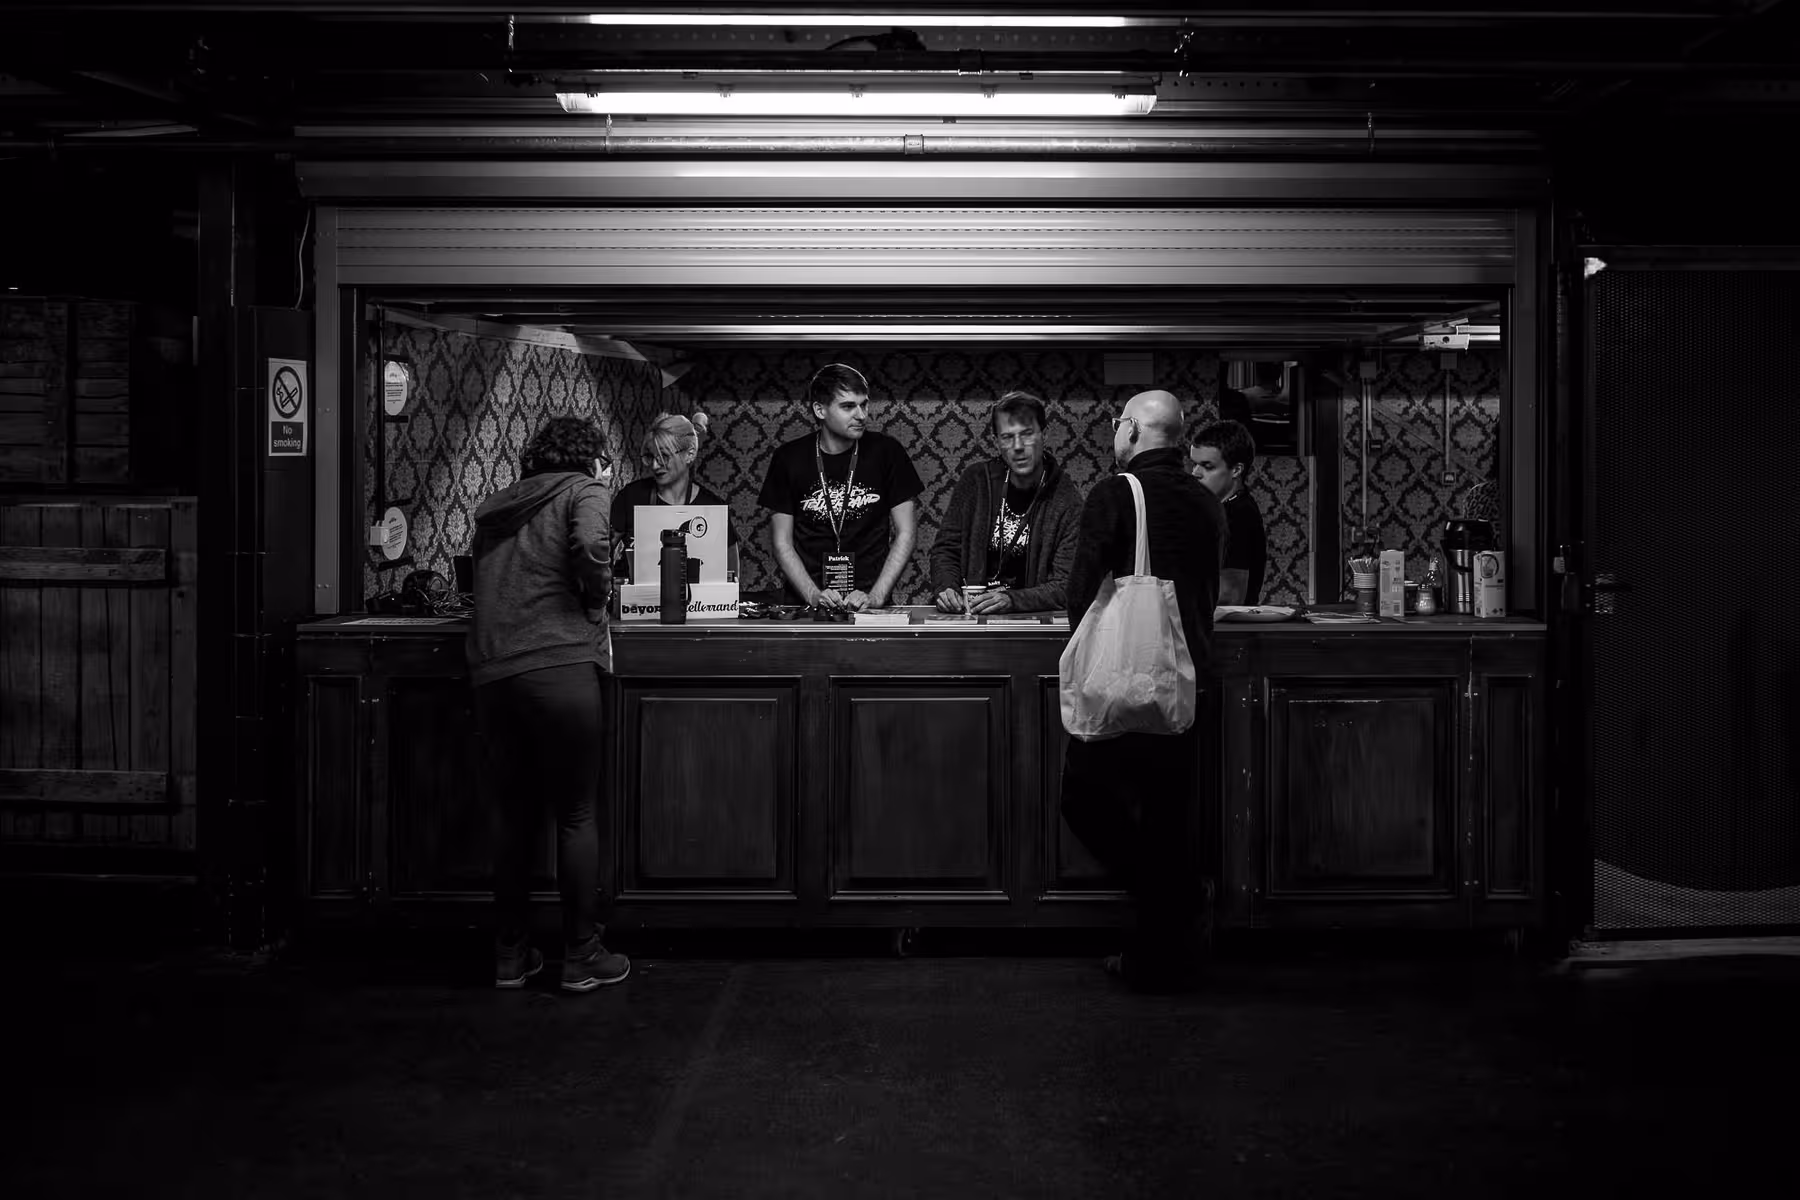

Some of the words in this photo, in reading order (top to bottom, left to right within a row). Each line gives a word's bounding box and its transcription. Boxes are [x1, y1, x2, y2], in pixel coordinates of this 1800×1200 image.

[282, 425, 293, 435] No
[273, 438, 301, 450] smoking
[686, 600, 739, 613] ellerrand
